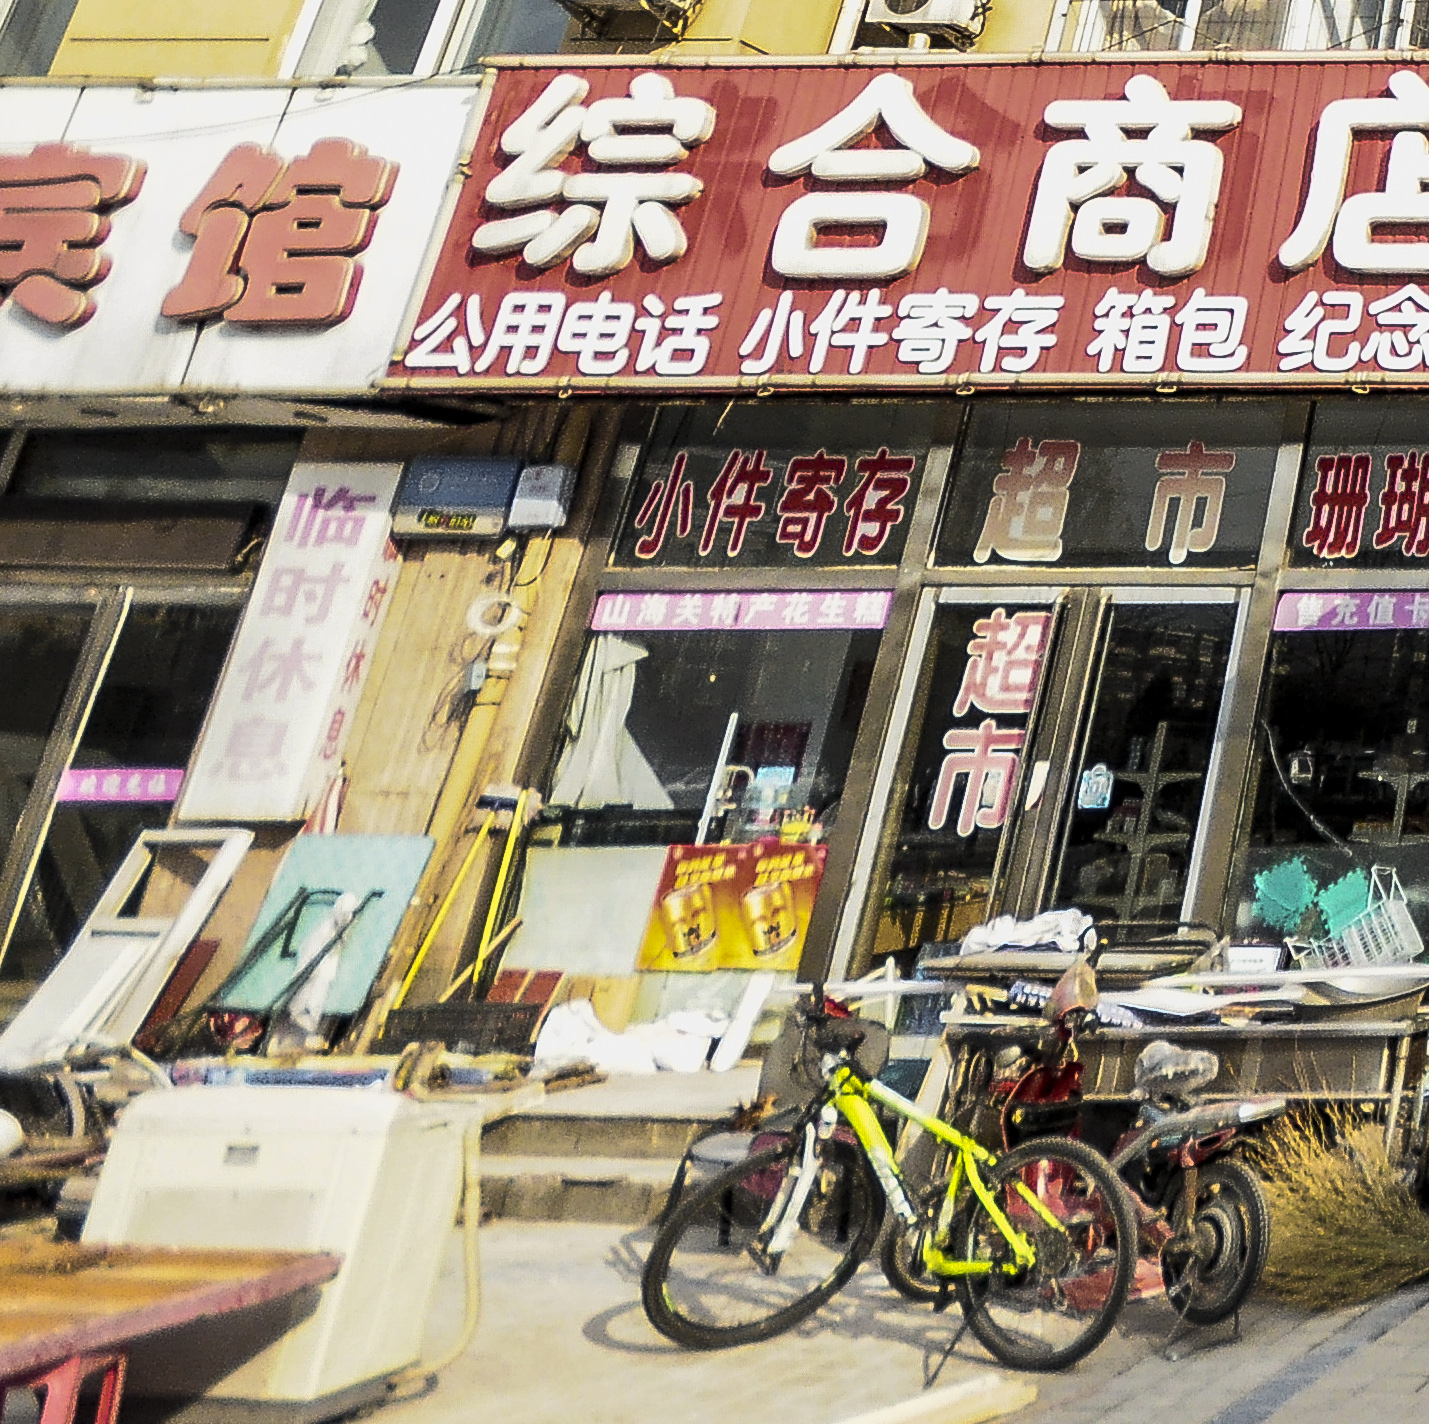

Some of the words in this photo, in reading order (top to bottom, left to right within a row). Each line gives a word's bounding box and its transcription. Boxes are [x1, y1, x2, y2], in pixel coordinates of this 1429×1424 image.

[405, 290, 724, 376] 公用电话
[740, 286, 1065, 375] 小件寄存
[1085, 287, 1246, 375] 箱包
[634, 447, 916, 559] 小件寄存
[973, 437, 1236, 565] 超市
[207, 486, 377, 783] 临时休息
[928, 608, 1054, 837] 超市
